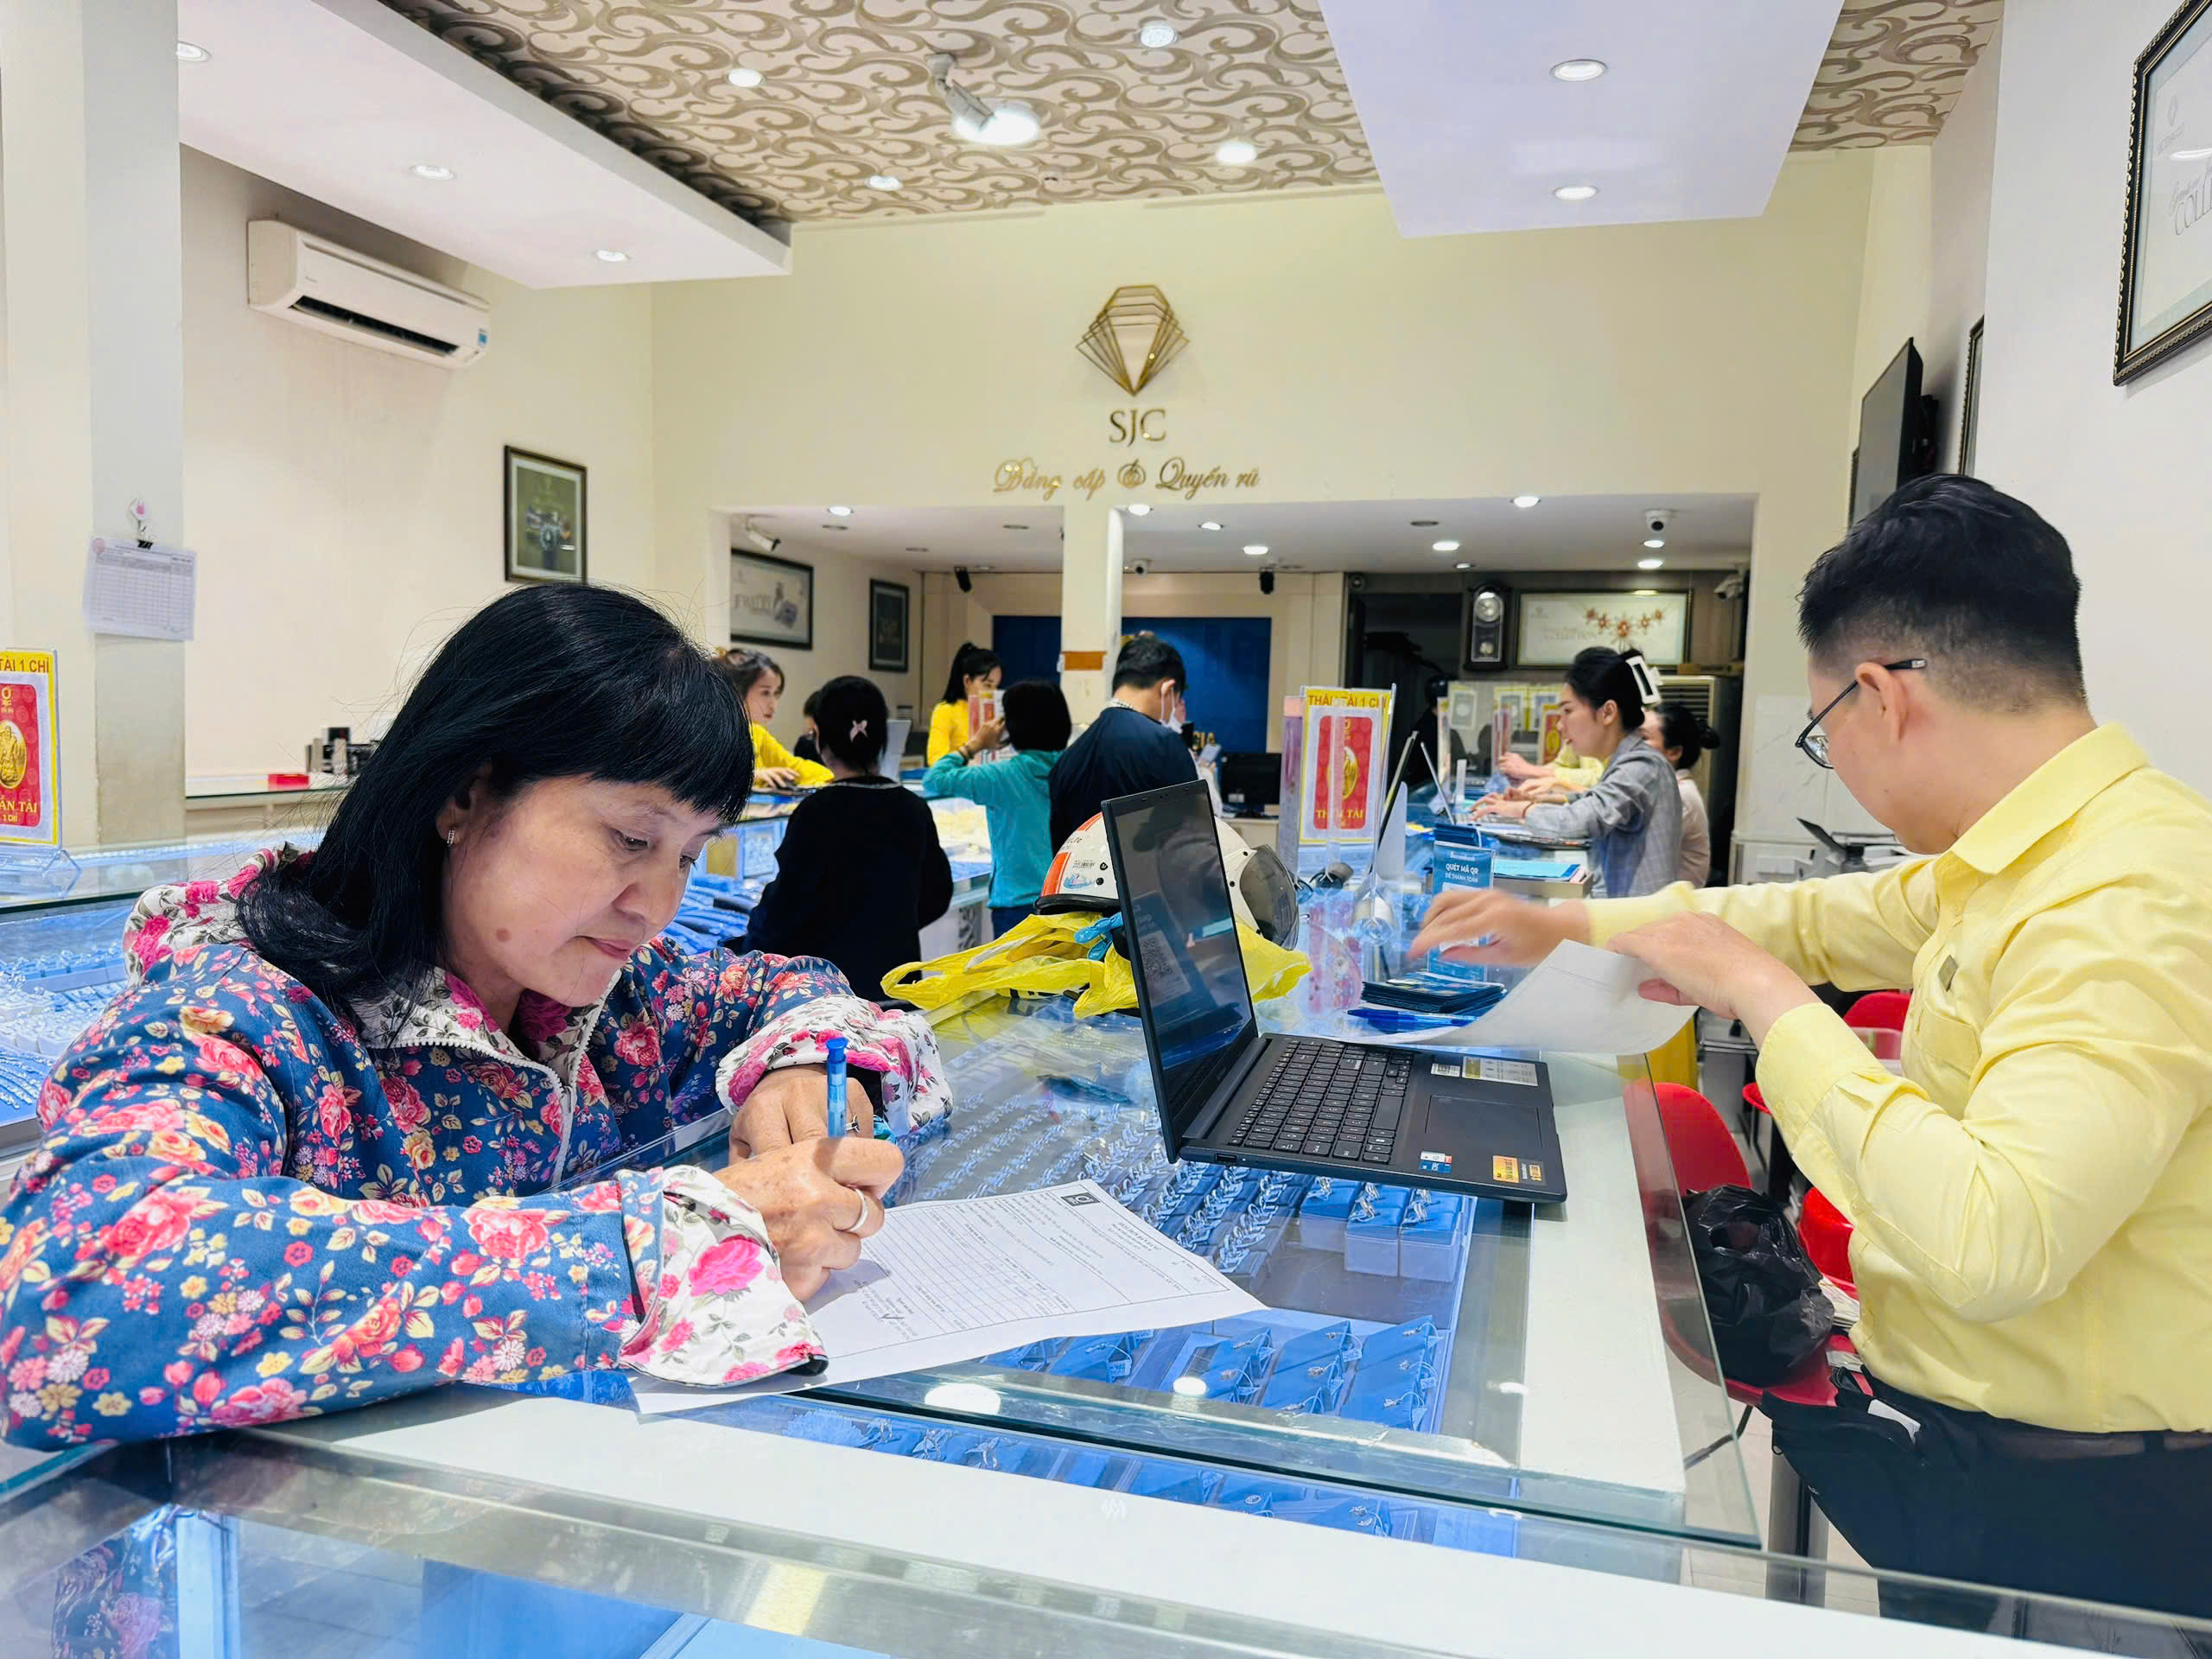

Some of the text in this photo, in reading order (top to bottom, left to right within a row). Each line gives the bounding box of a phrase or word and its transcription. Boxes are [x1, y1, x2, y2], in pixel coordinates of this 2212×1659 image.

[1109, 409, 1166, 448] SJC
[1155, 456, 1230, 500] Quyến
[19, 659, 25, 672] 1
[1470, 867, 1479, 876] QR
